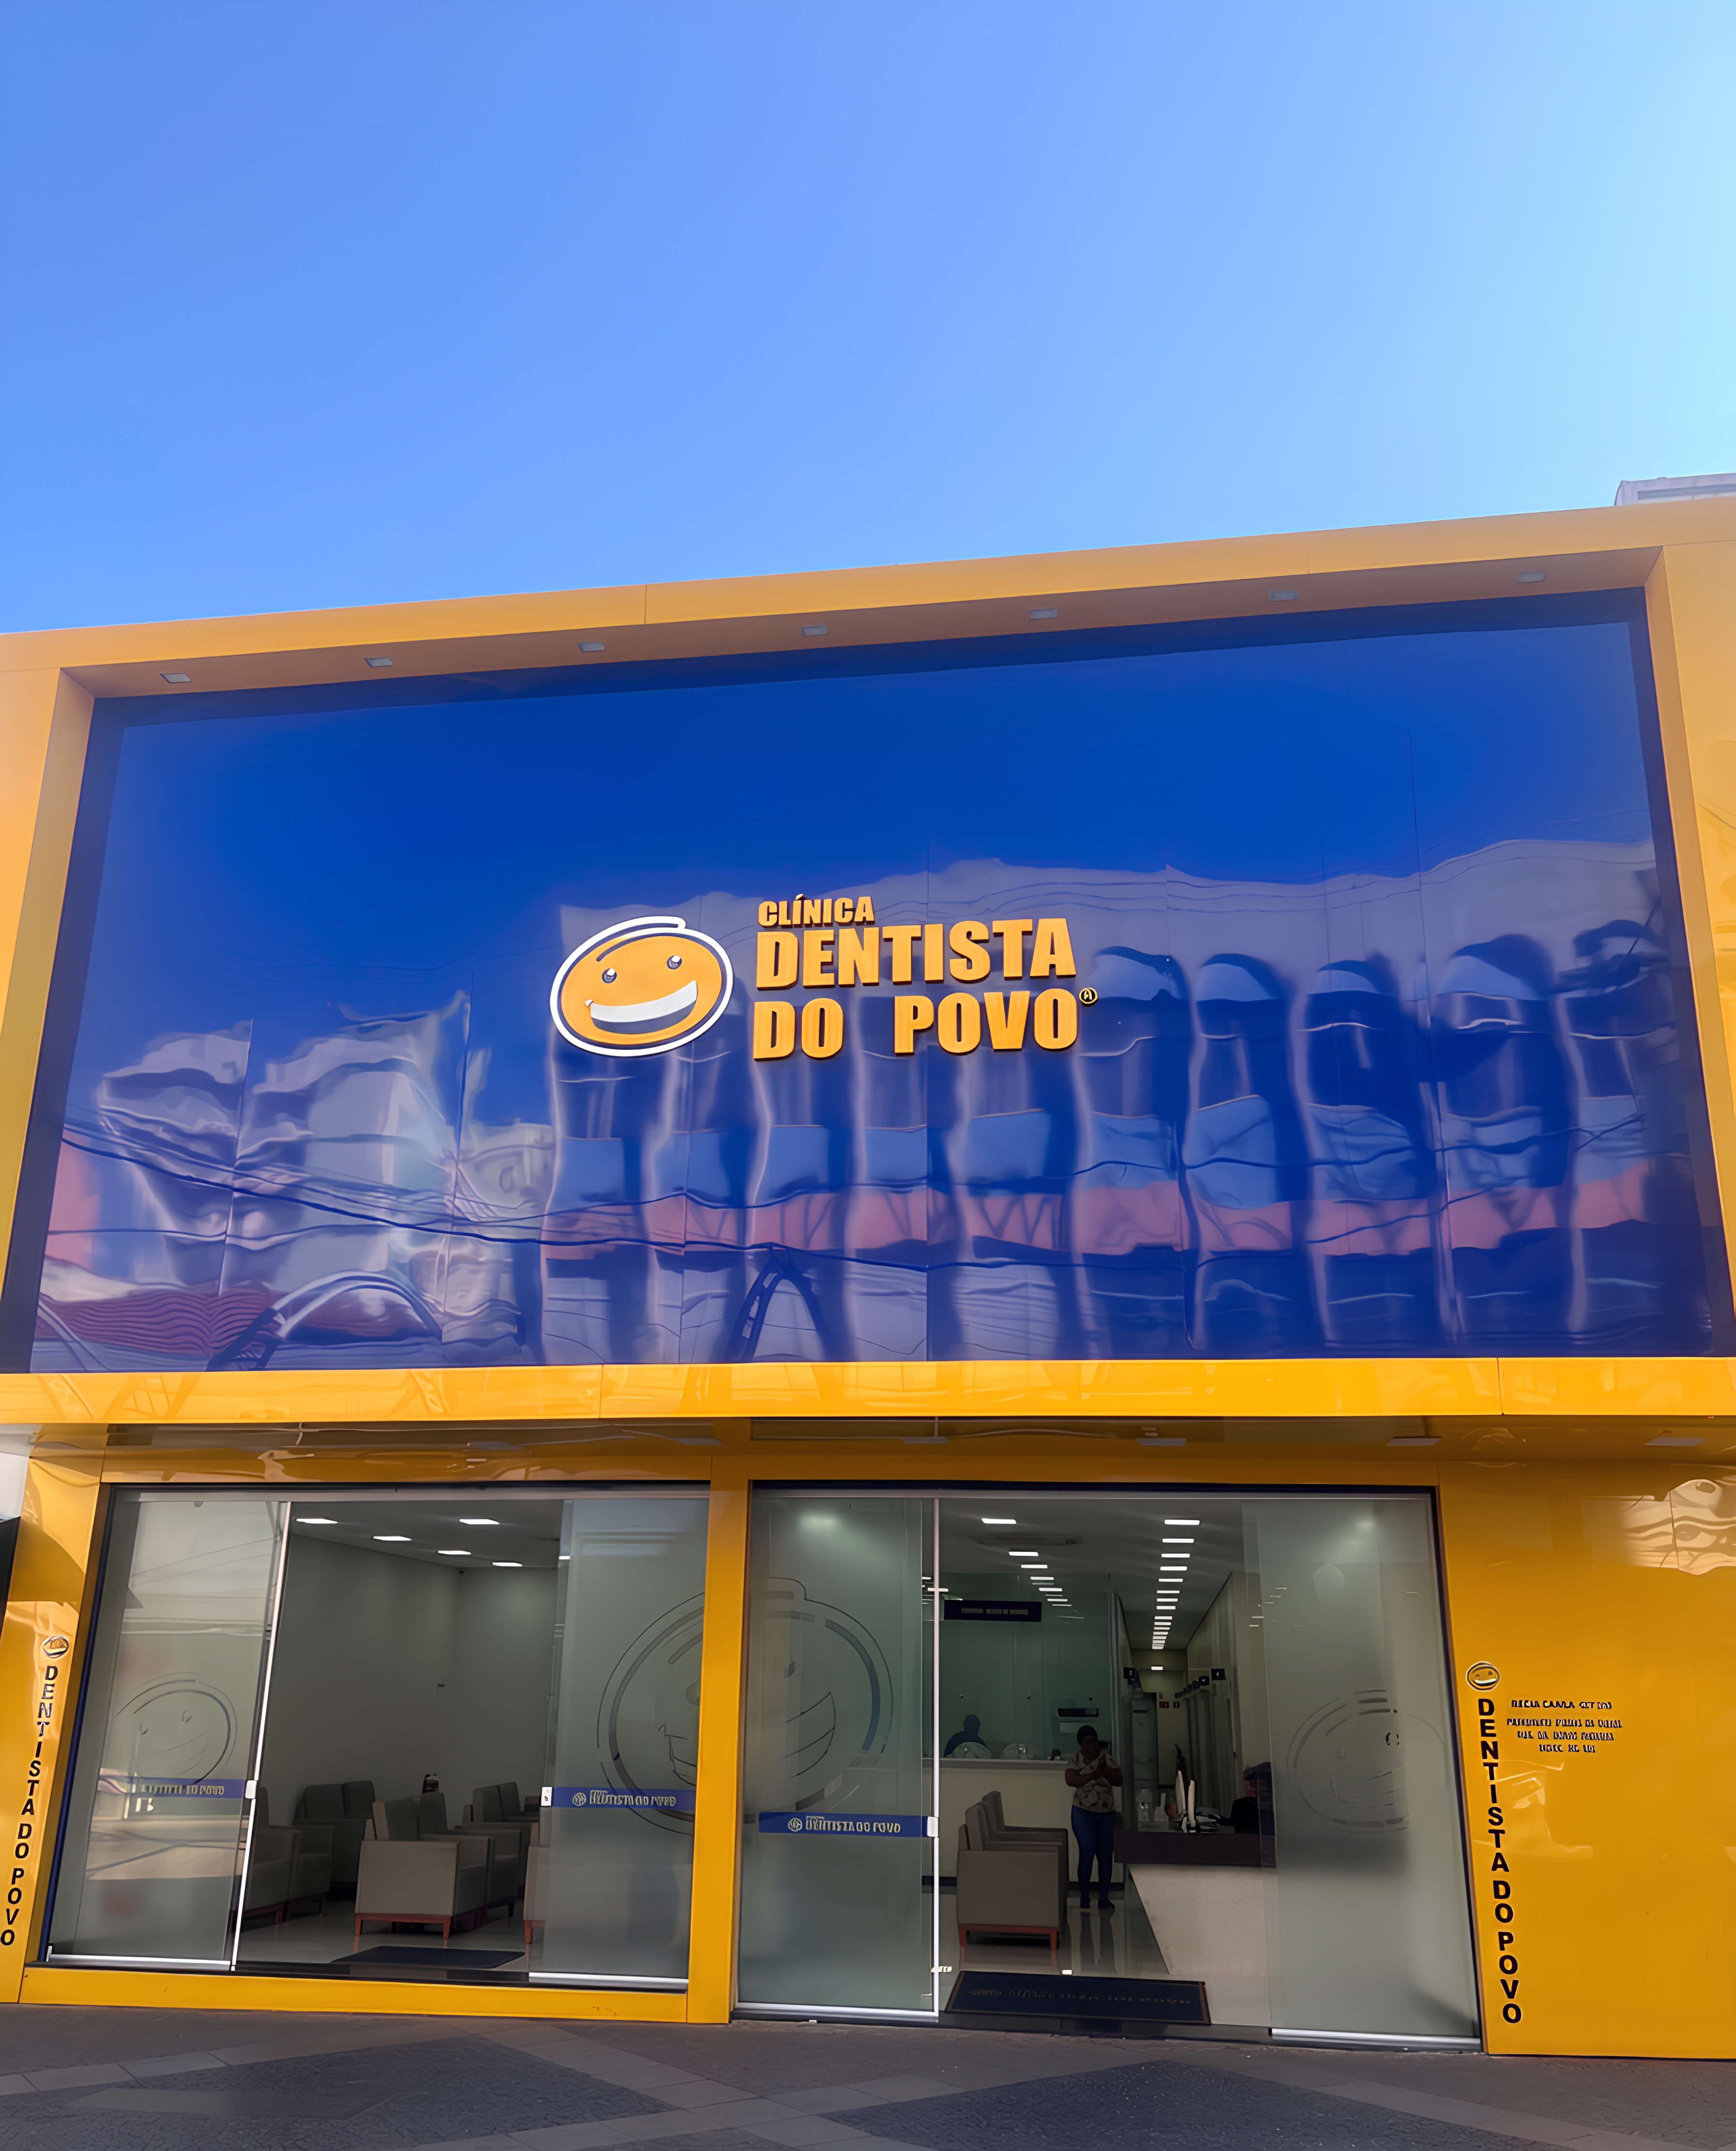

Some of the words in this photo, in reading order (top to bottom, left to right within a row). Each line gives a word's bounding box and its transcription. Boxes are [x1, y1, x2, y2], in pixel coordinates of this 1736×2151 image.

[758, 894, 875, 928] CLÍNICA
[756, 918, 1077, 990] DENTISTA
[752, 998, 844, 1060] DO
[893, 988, 1078, 1056] POVO
[21, 1665, 58, 1816] DENTISTA
[1478, 1698, 1510, 1873] DENTISTA
[15, 1823, 32, 1859] DO
[0, 1867, 25, 1946] POVO
[1493, 1880, 1514, 1924] DO
[1498, 1931, 1522, 2024] POVO
